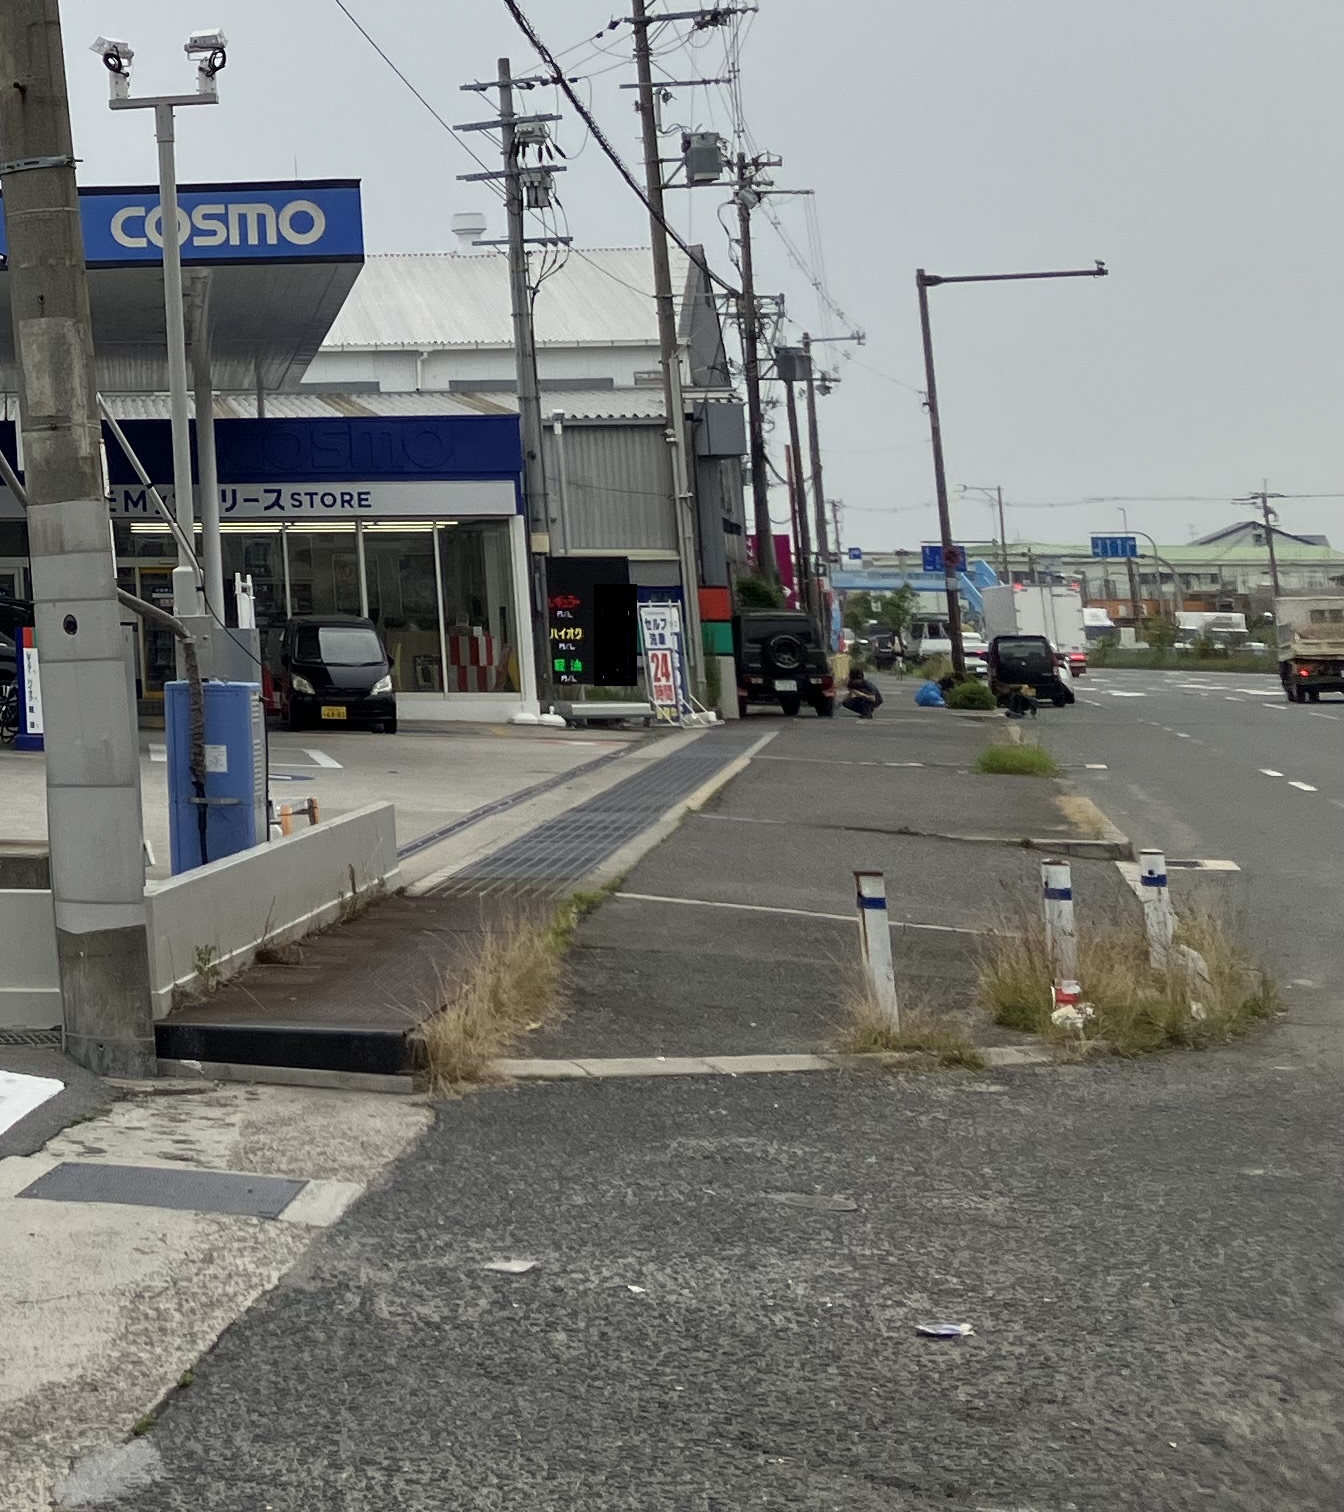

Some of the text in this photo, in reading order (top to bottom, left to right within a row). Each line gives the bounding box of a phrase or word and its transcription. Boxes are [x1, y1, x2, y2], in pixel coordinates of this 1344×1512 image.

[111, 200, 326, 248] COSMO
[550, 628, 583, 640] ハイオク
[645, 618, 667, 630] セルフ
[651, 653, 670, 682] 24
